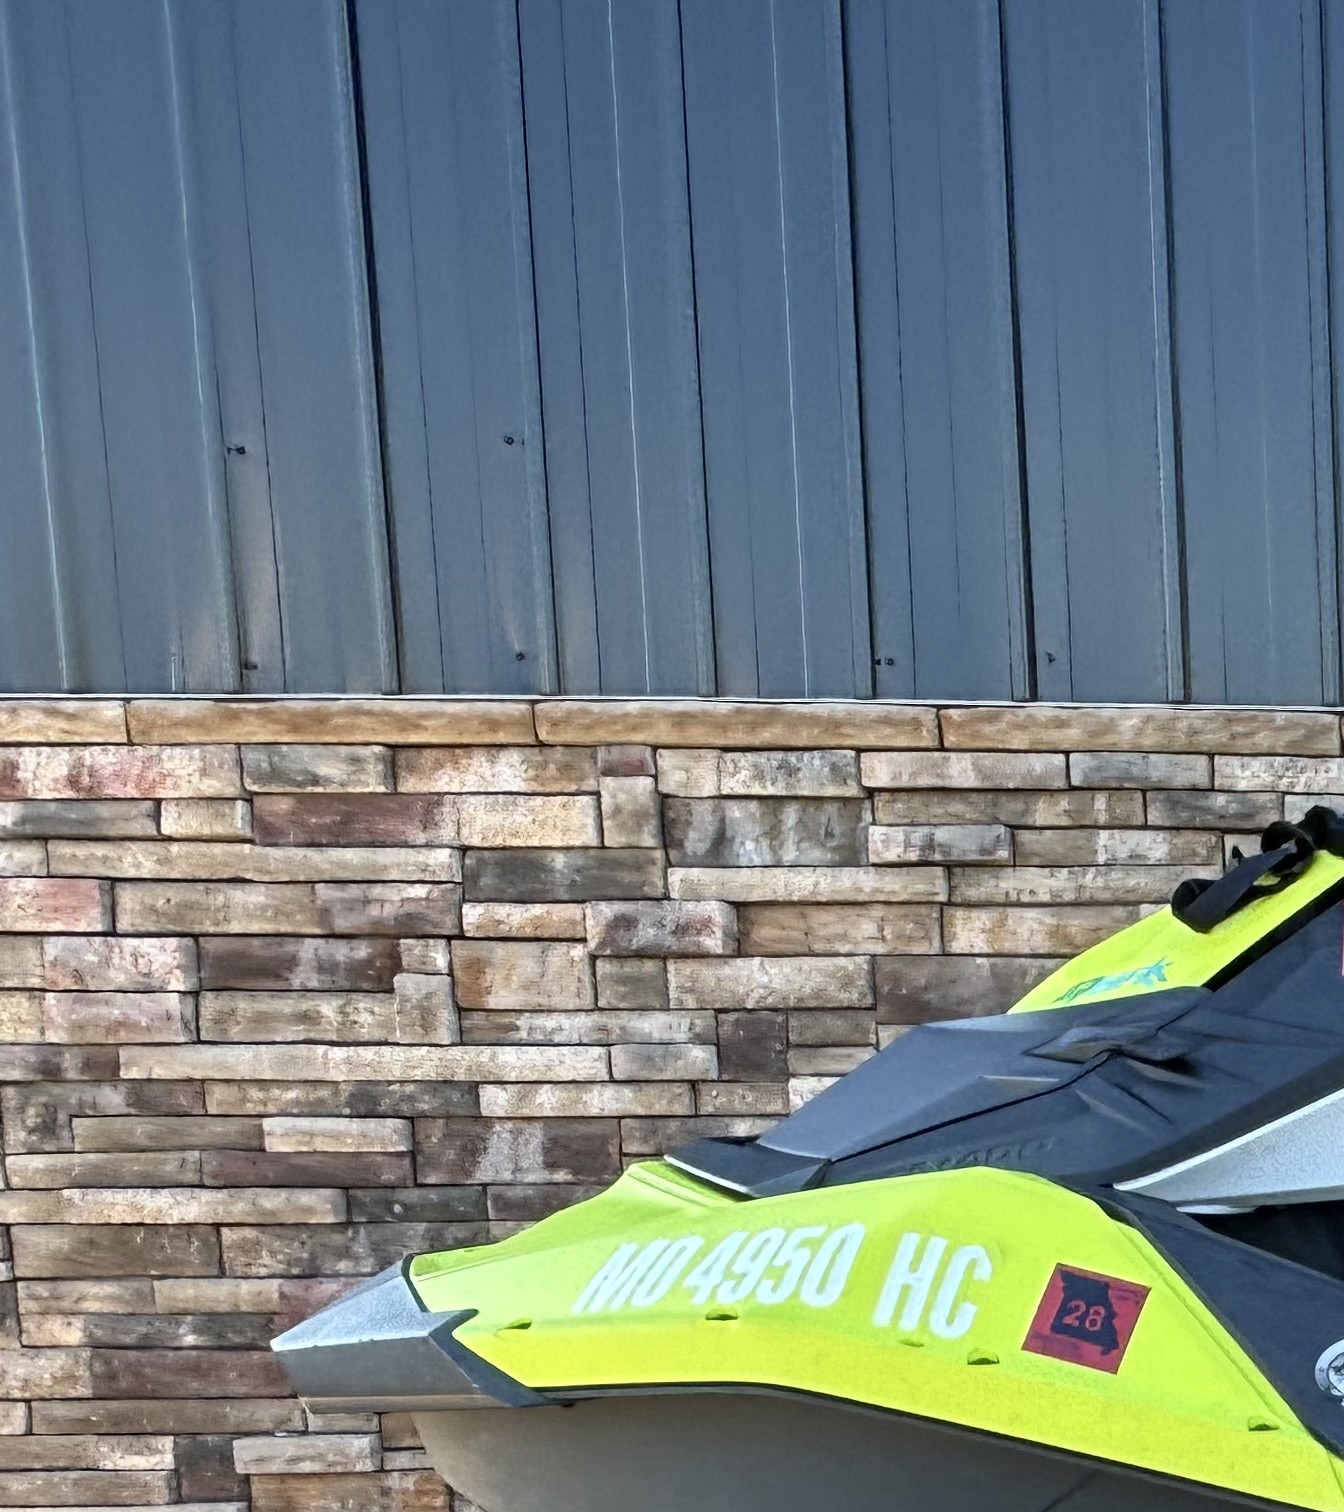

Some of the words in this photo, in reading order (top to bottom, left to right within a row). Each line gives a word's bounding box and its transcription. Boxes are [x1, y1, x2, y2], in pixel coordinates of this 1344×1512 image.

[572, 1235, 704, 1314] MO
[682, 1223, 866, 1308] 4950
[871, 1232, 992, 1339] HC
[1062, 1300, 1106, 1332] 28
